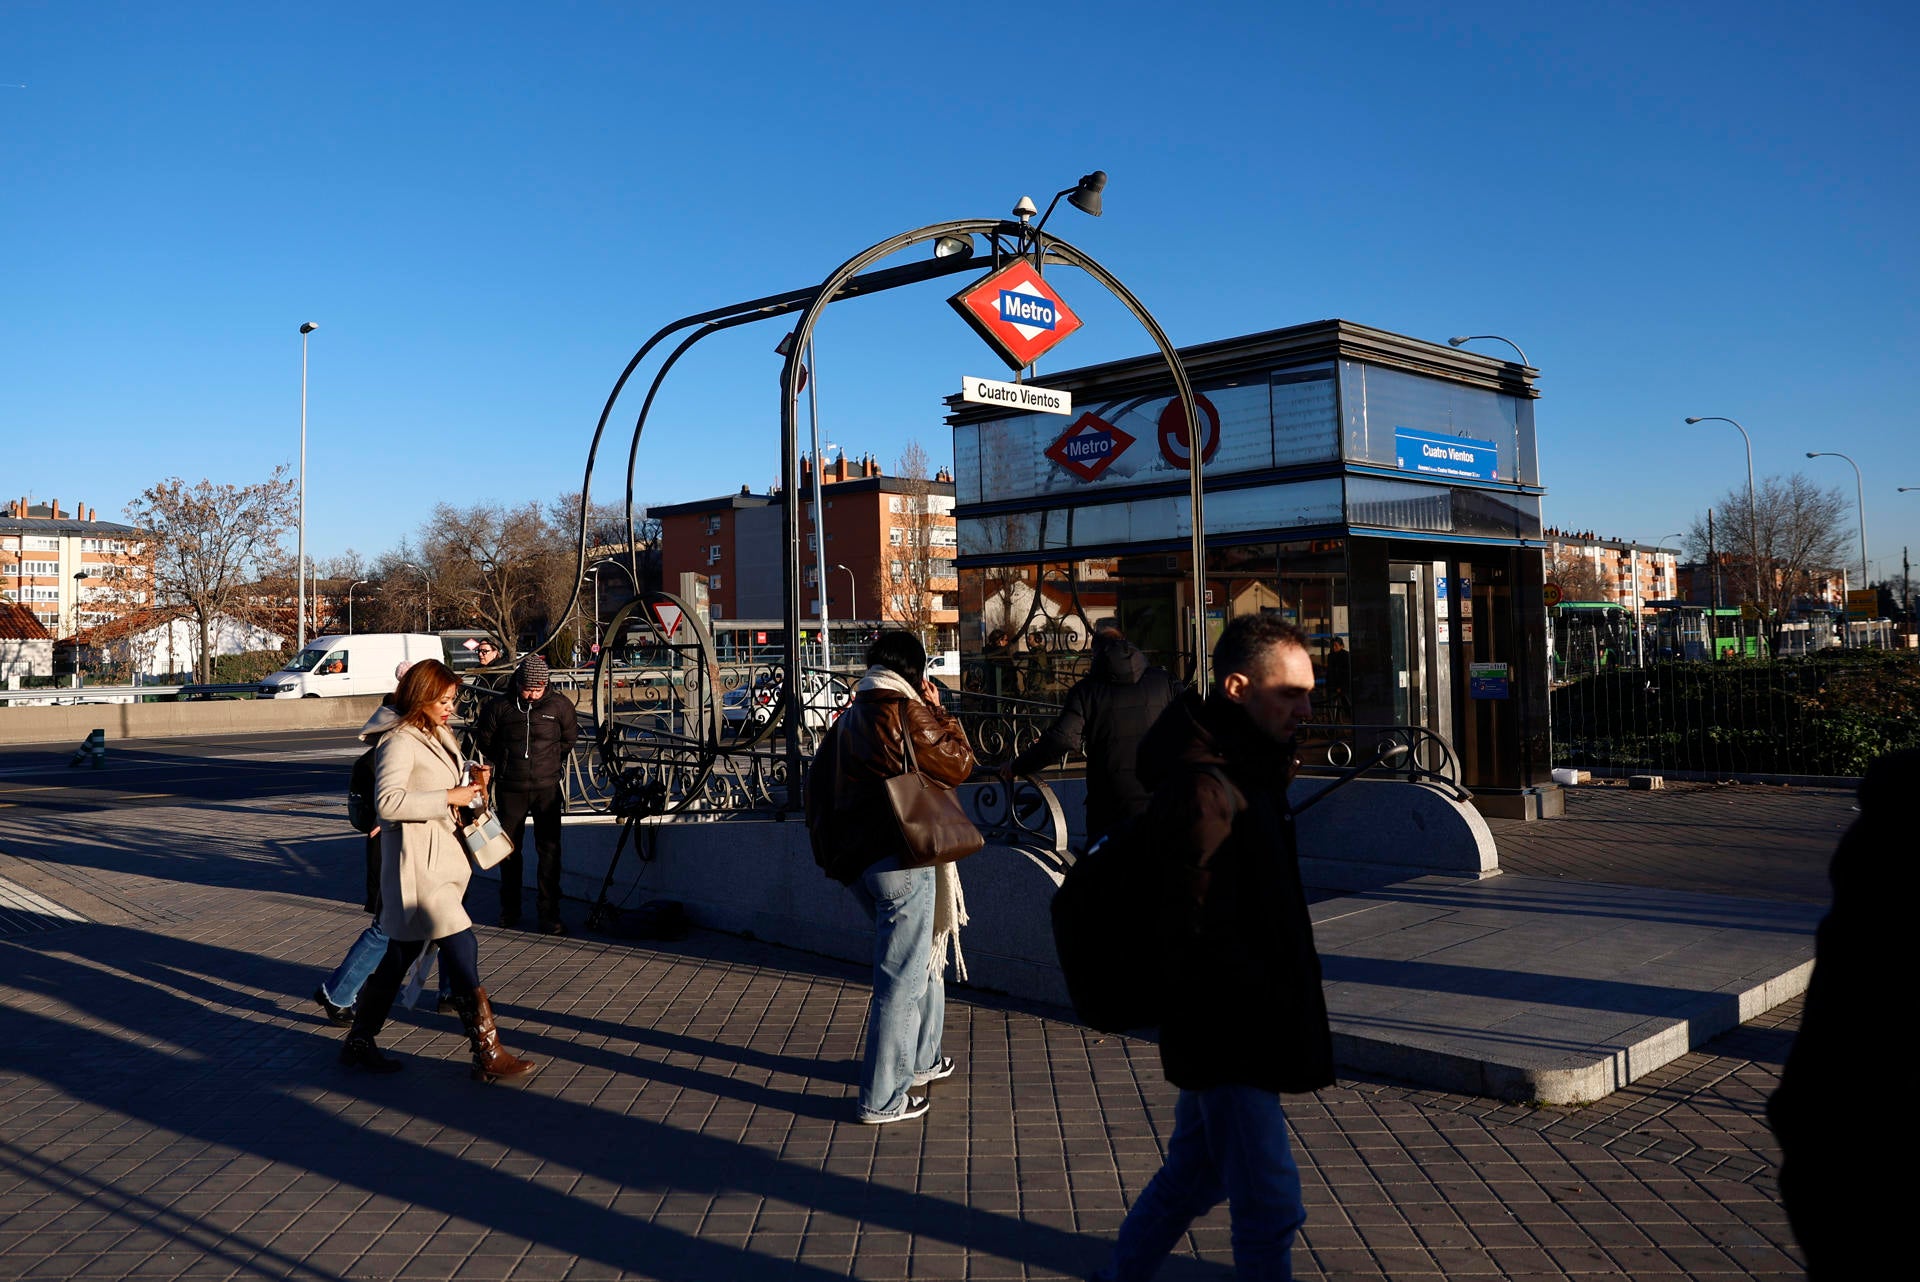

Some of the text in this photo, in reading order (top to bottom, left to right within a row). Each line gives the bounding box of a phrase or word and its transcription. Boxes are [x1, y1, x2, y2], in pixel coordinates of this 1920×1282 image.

[1005, 295, 1052, 324] Metro
[978, 382, 1060, 408] Cuatro Vientos
[1069, 440, 1109, 457] Metro
[1422, 444, 1474, 463] Cuatro Vientos
